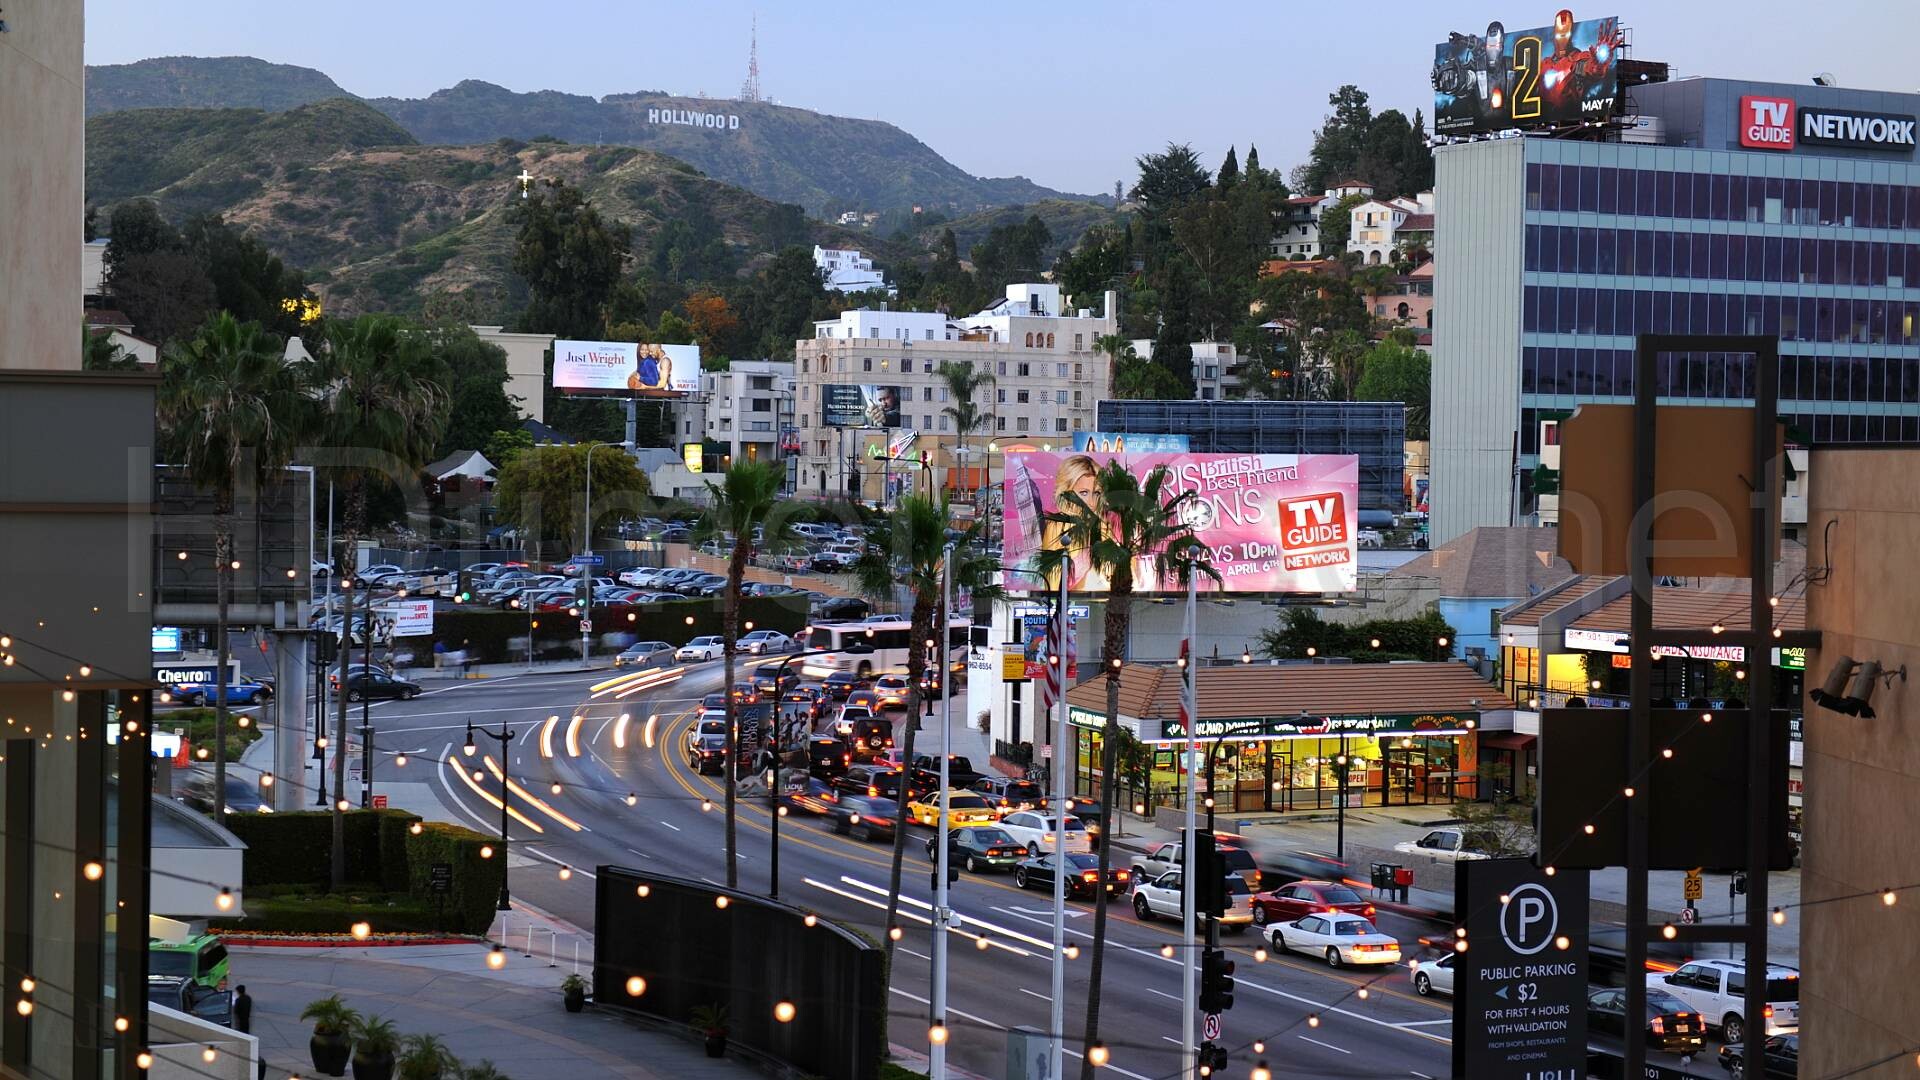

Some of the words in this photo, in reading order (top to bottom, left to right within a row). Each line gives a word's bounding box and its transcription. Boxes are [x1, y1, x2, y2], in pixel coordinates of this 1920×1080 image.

[1512, 36, 1541, 119] 2
[1581, 100, 1602, 112] MAY
[1605, 98, 1613, 109] 7
[1751, 100, 1789, 127] TV
[648, 108, 740, 130] HOLLYWOOD
[1748, 125, 1791, 143] GUIDE
[1804, 113, 1915, 145] NETWORK
[565, 351, 586, 363] Just
[588, 352, 625, 368] Wright
[1203, 456, 1262, 477] British
[1205, 472, 1243, 491] Best
[1247, 465, 1299, 485] Friend
[1288, 498, 1336, 528] TV
[1287, 524, 1343, 546] GUIDE
[1239, 541, 1278, 560] 10PM
[1286, 550, 1348, 568] NETWORK
[1226, 564, 1259, 576] APRIL
[1262, 560, 1280, 572] 6TH
[1024, 616, 1047, 625] SOUTH
[157, 669, 212, 683] Chevron
[1686, 880, 1700, 892] 25
[1519, 897, 1546, 943] P
[1480, 966, 1522, 981] PUBLIC
[1525, 963, 1577, 978] PARKING
[1518, 983, 1538, 1003] $2
[1485, 1010, 1503, 1020] FOR
[1506, 1008, 1528, 1018] FIRST
[1530, 1007, 1537, 1017] 4
[1538, 1005, 1570, 1016] HOURS
[1487, 1024, 1512, 1035] WITH
[1513, 1020, 1567, 1033] VALIDATION
